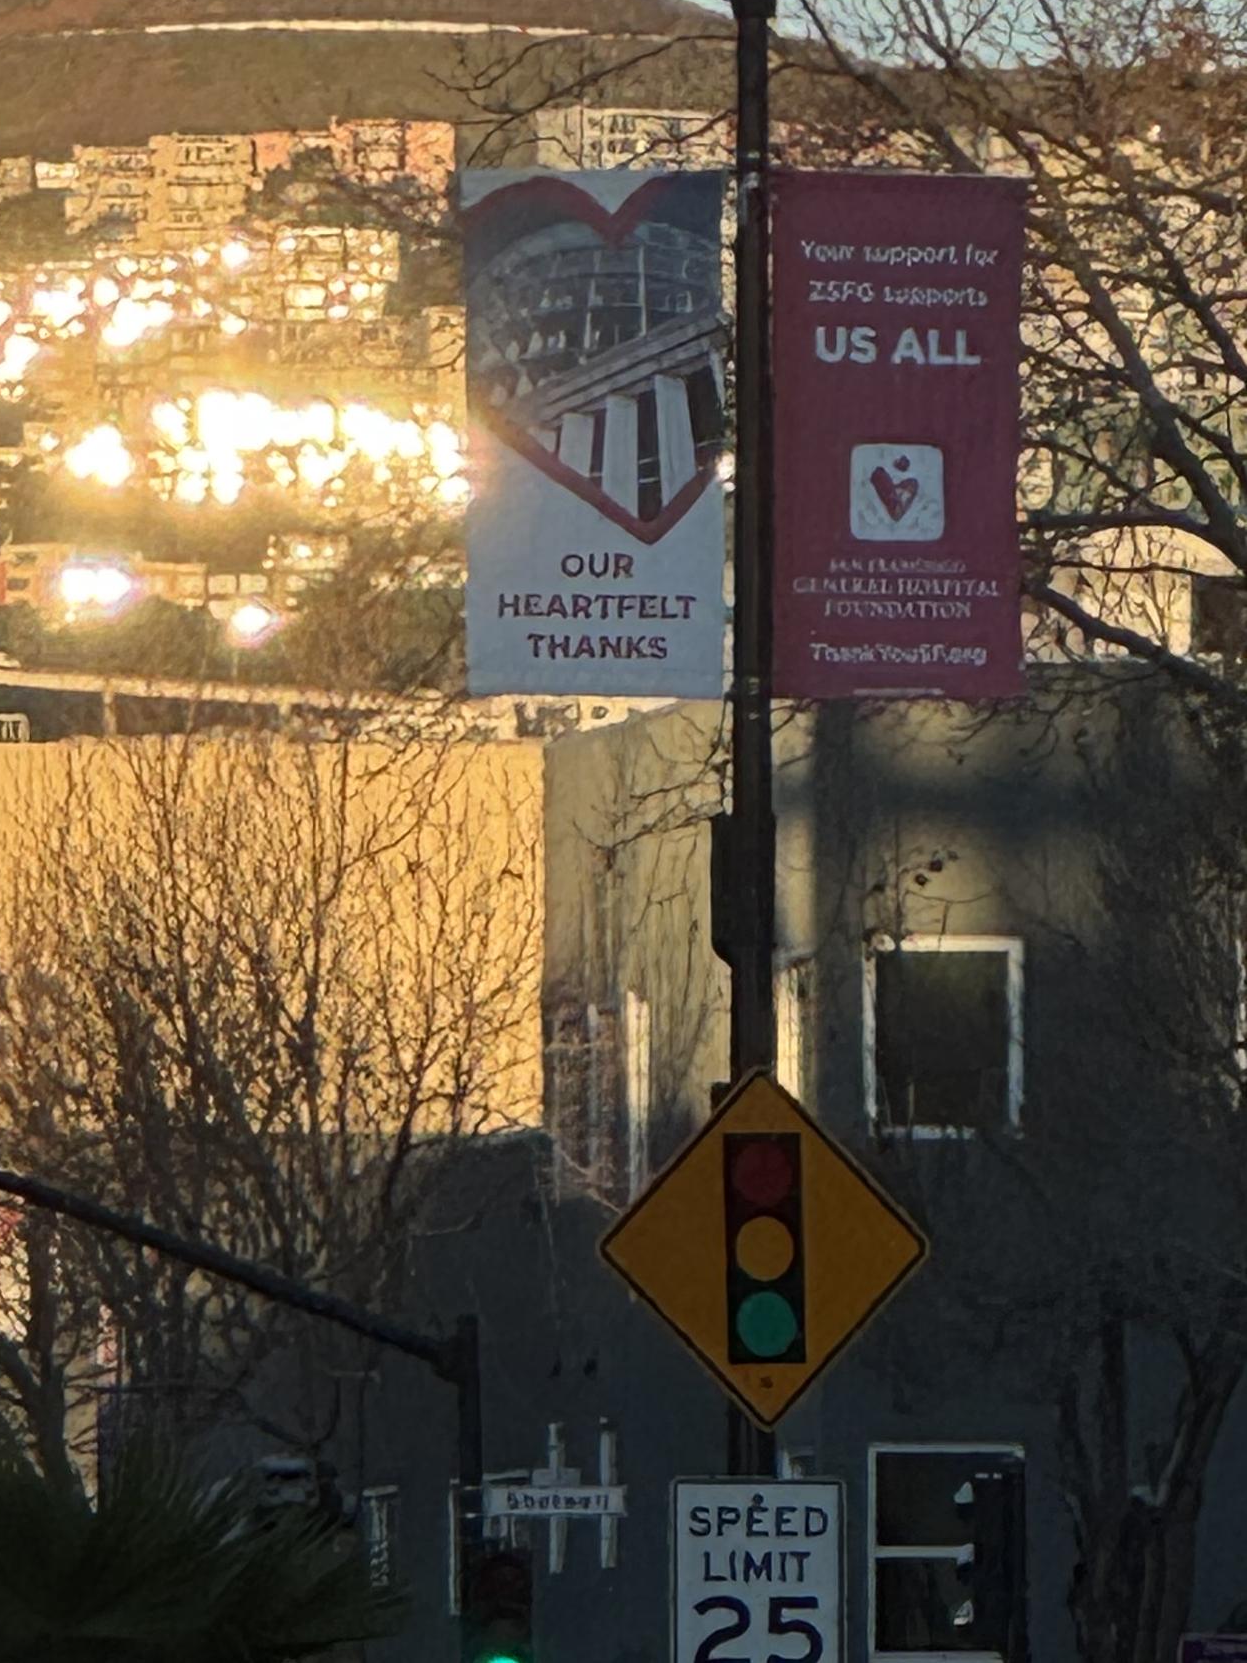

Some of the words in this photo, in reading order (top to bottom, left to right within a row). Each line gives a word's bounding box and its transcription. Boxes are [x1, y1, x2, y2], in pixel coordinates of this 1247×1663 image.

[800, 240, 855, 262] Your
[863, 245, 957, 266] support
[965, 244, 1000, 265] for
[883, 285, 988, 307] supports
[815, 326, 877, 364] US
[890, 326, 982, 365] ALL
[560, 552, 635, 579] OUR
[497, 594, 697, 620] HEARTFELT
[824, 599, 972, 619] FOUNDATION
[527, 633, 668, 660] THANKS
[688, 1505, 829, 1537] SPEED
[703, 1549, 812, 1583] LIMIT
[692, 1595, 824, 1663] 25
